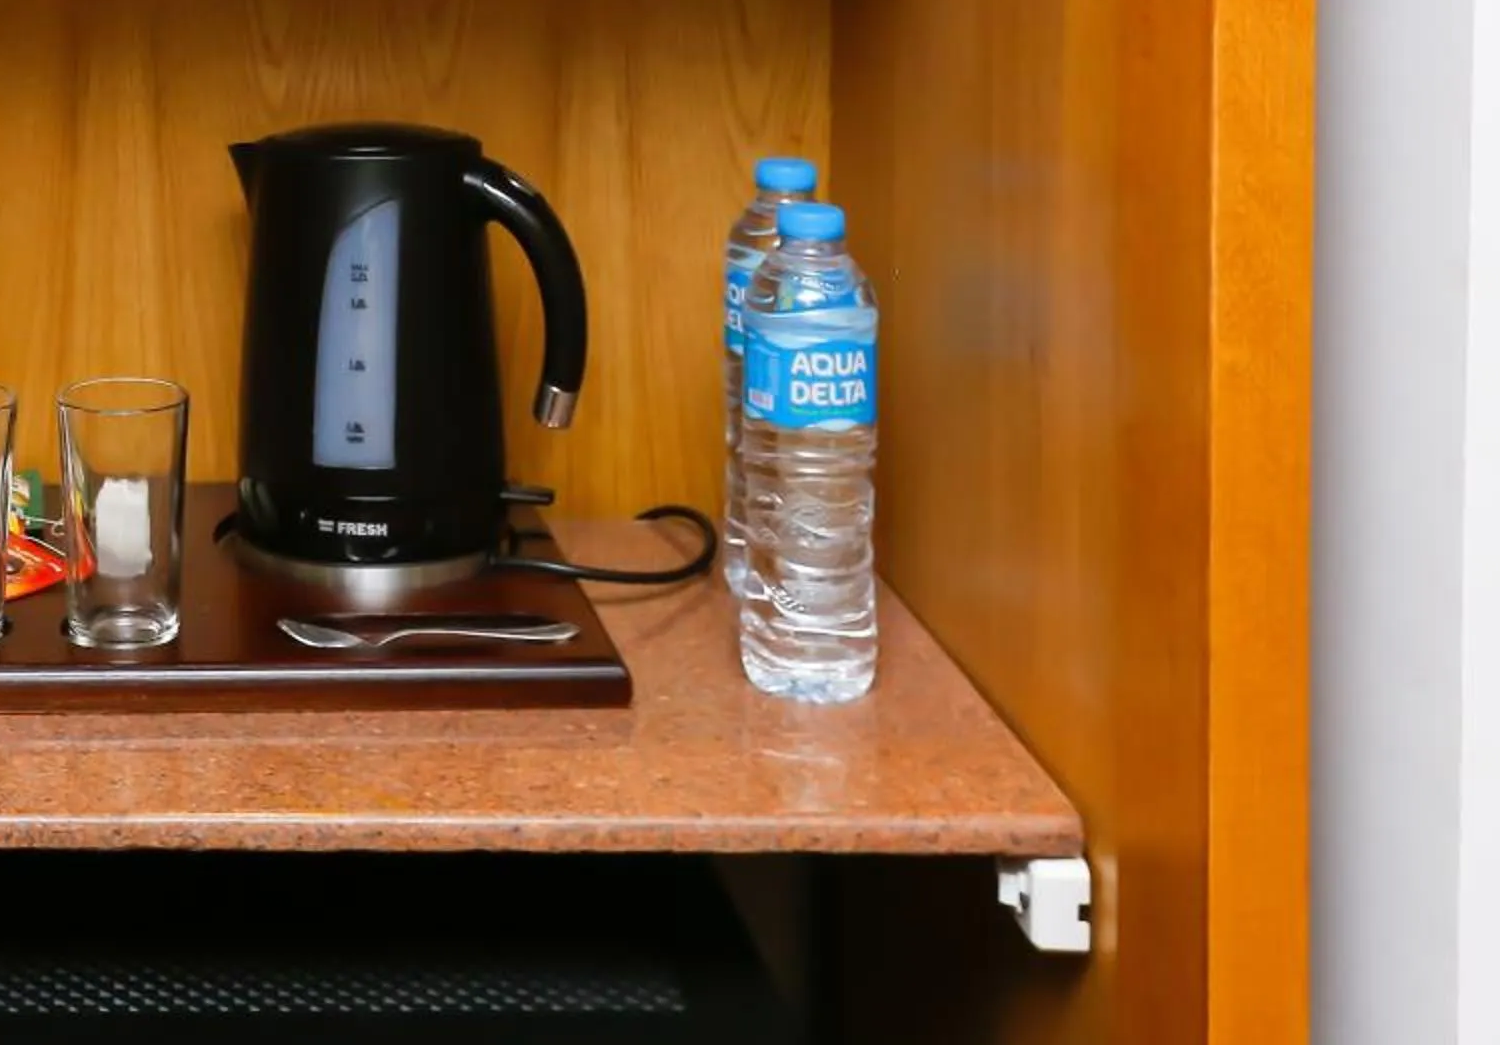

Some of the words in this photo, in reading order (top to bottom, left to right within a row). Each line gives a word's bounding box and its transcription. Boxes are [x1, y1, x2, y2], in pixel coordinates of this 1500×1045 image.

[790, 350, 867, 376] AQUA
[789, 379, 867, 406] DELTA
[337, 521, 389, 537] FRESH
